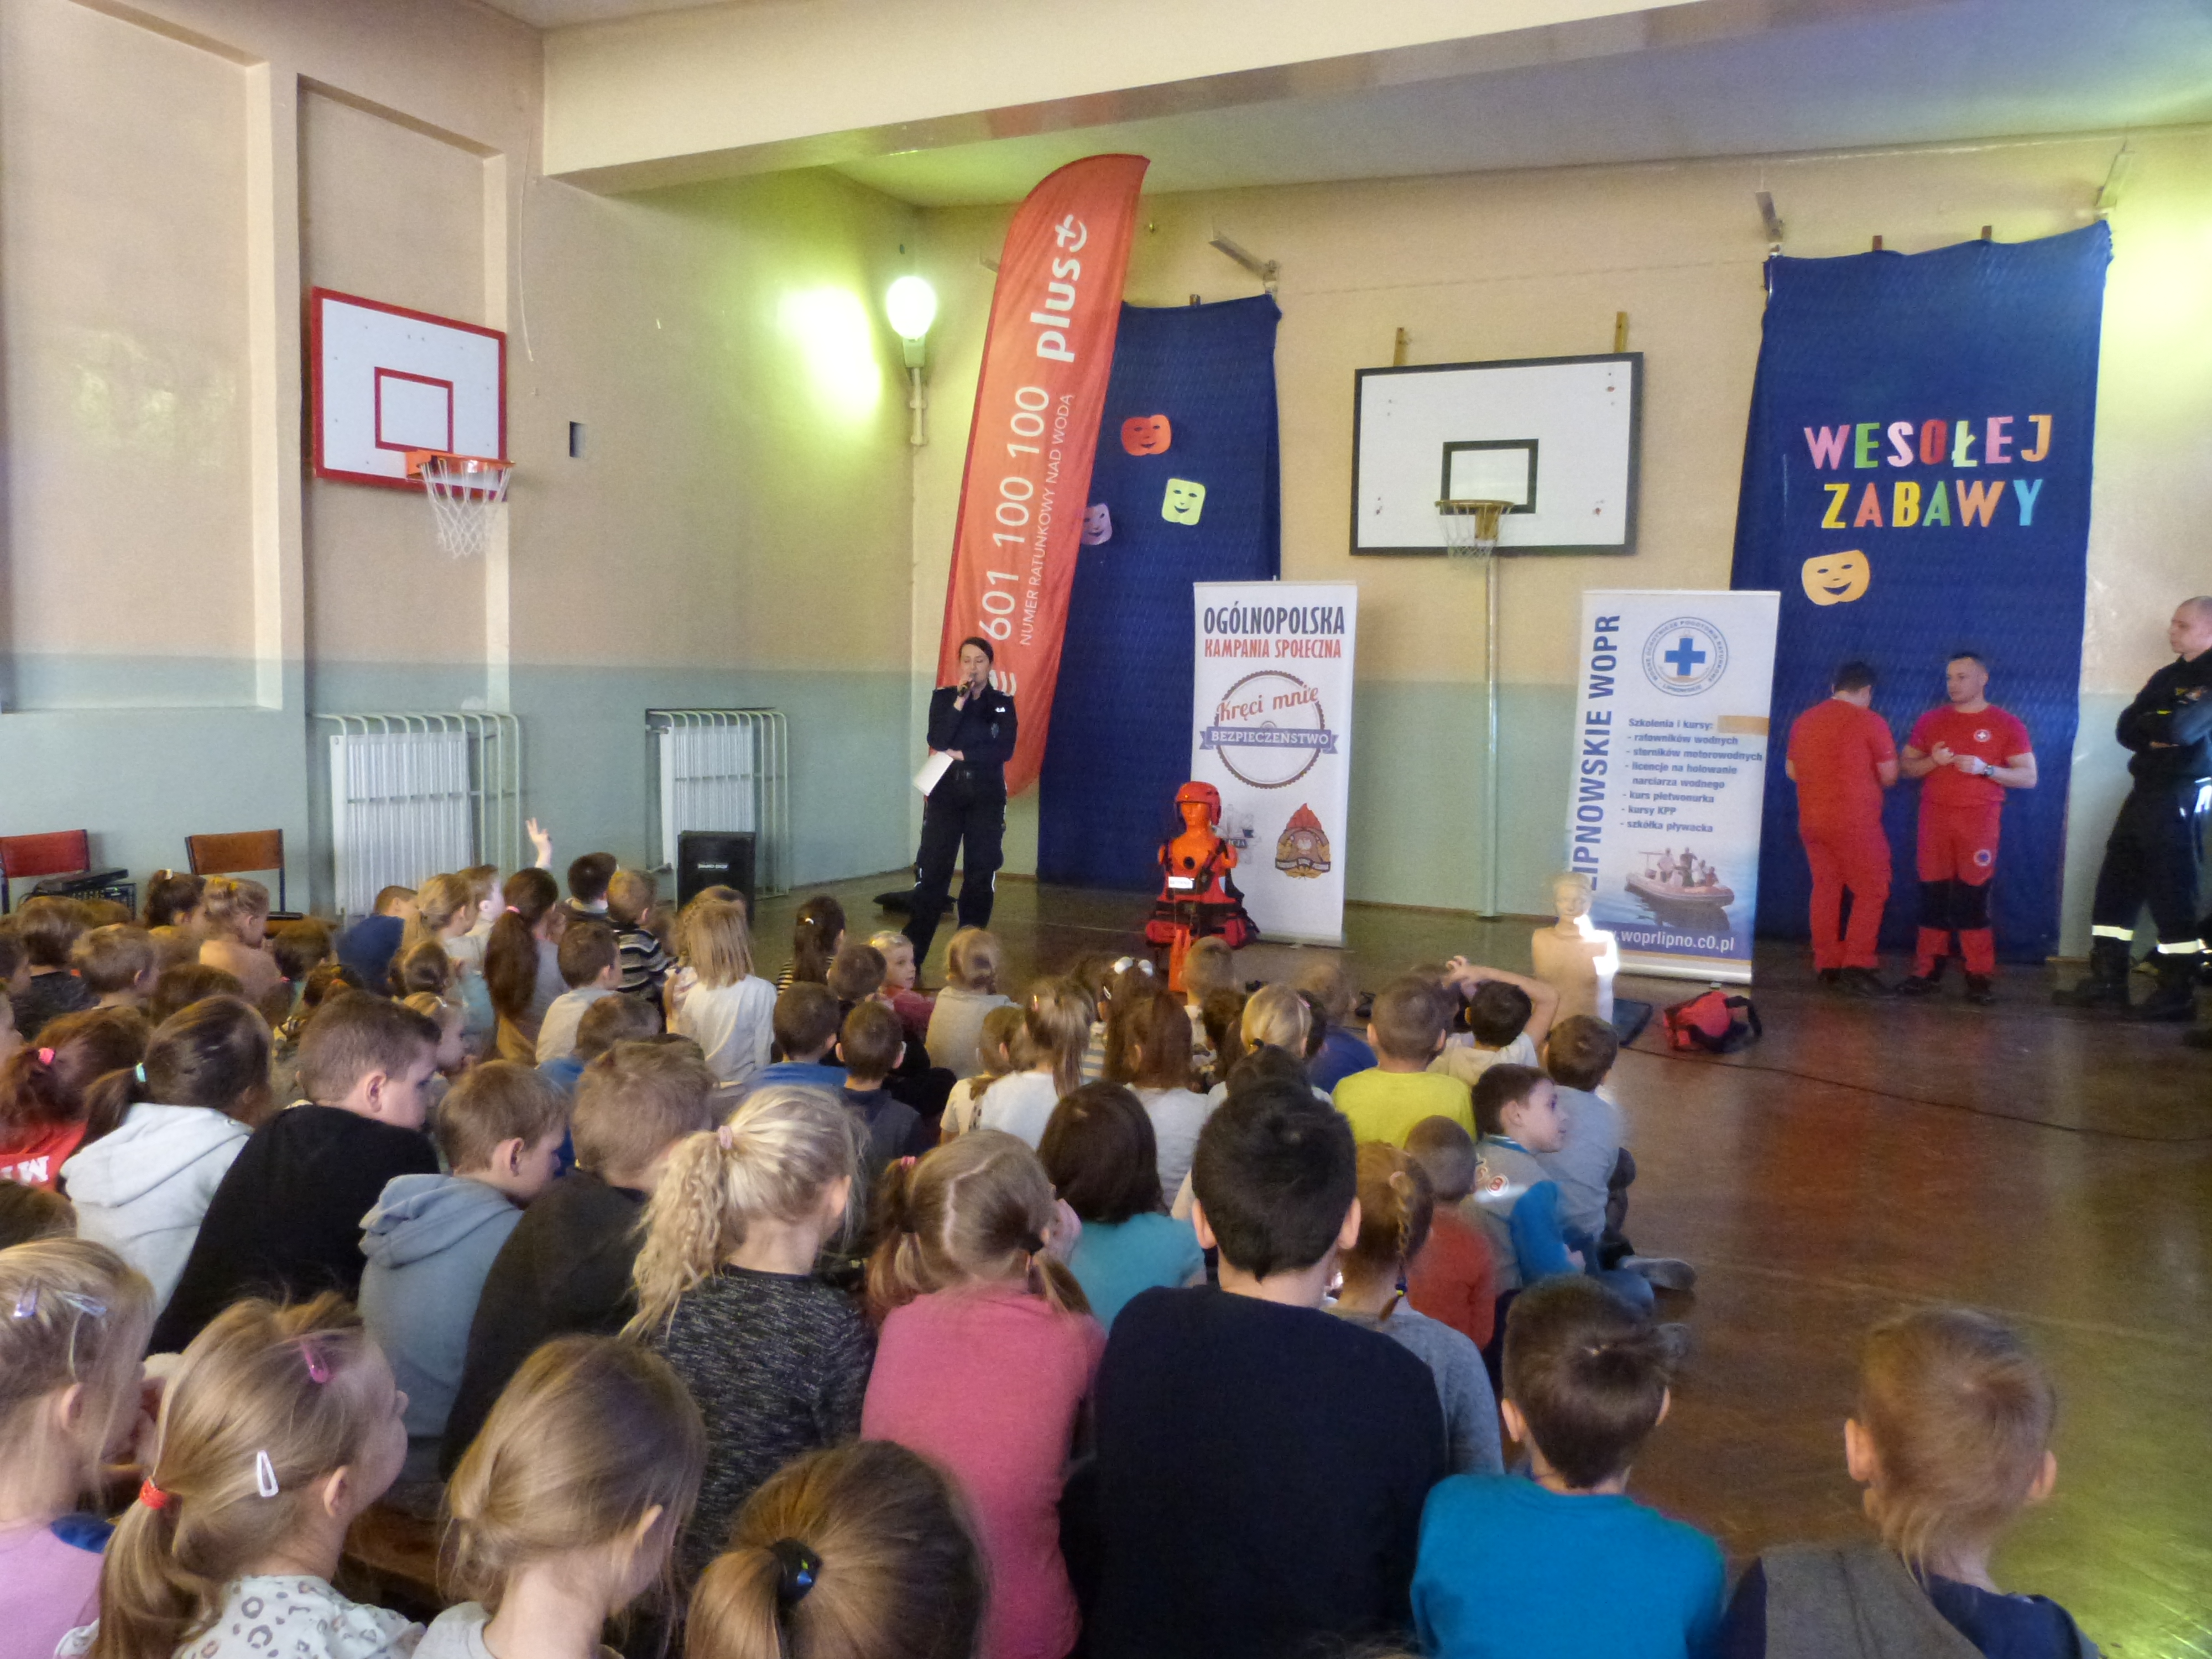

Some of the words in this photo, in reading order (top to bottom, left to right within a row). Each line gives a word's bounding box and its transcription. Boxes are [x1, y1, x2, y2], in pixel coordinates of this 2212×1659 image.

[1030, 258, 1081, 363] plus
[1007, 386, 1049, 458] 100
[1804, 415, 2053, 470] WESOŁEJ
[993, 477, 1034, 547] 100
[1821, 479, 2043, 529] ZABAWY
[1019, 589, 1039, 646] NUMER
[1029, 488, 1055, 586] RATUNKOWY
[1045, 449, 1061, 483] NAD
[979, 571, 1019, 641] 601
[1204, 601, 1344, 634] OGÓLNOPOLSKA
[1204, 639, 1270, 658] KAMPANIA
[1275, 639, 1341, 658] SPOŁECZNA
[1588, 615, 1620, 699] WOPR
[1217, 695, 1263, 721] Kręci
[1272, 685, 1318, 710] mnie
[1629, 718, 1674, 728] Szkolenia
[1211, 731, 1329, 744] BEZPIECZEŃSTWO
[1634, 733, 1691, 743] ratowników
[1694, 735, 1738, 747] wodnych
[1631, 761, 1668, 773] licencje
[1687, 765, 1738, 774] holowanie
[1633, 748, 1681, 757] sterników
[1683, 750, 1762, 761] motorowodnych
[1630, 790, 1650, 799] kurs
[1632, 777, 1677, 786] narciarza
[1681, 779, 1725, 790] wodnego
[1628, 805, 1655, 816] kursy
[1657, 806, 1676, 815] KPP
[1613, 930, 1734, 953] .woprlipno.c0.pl
